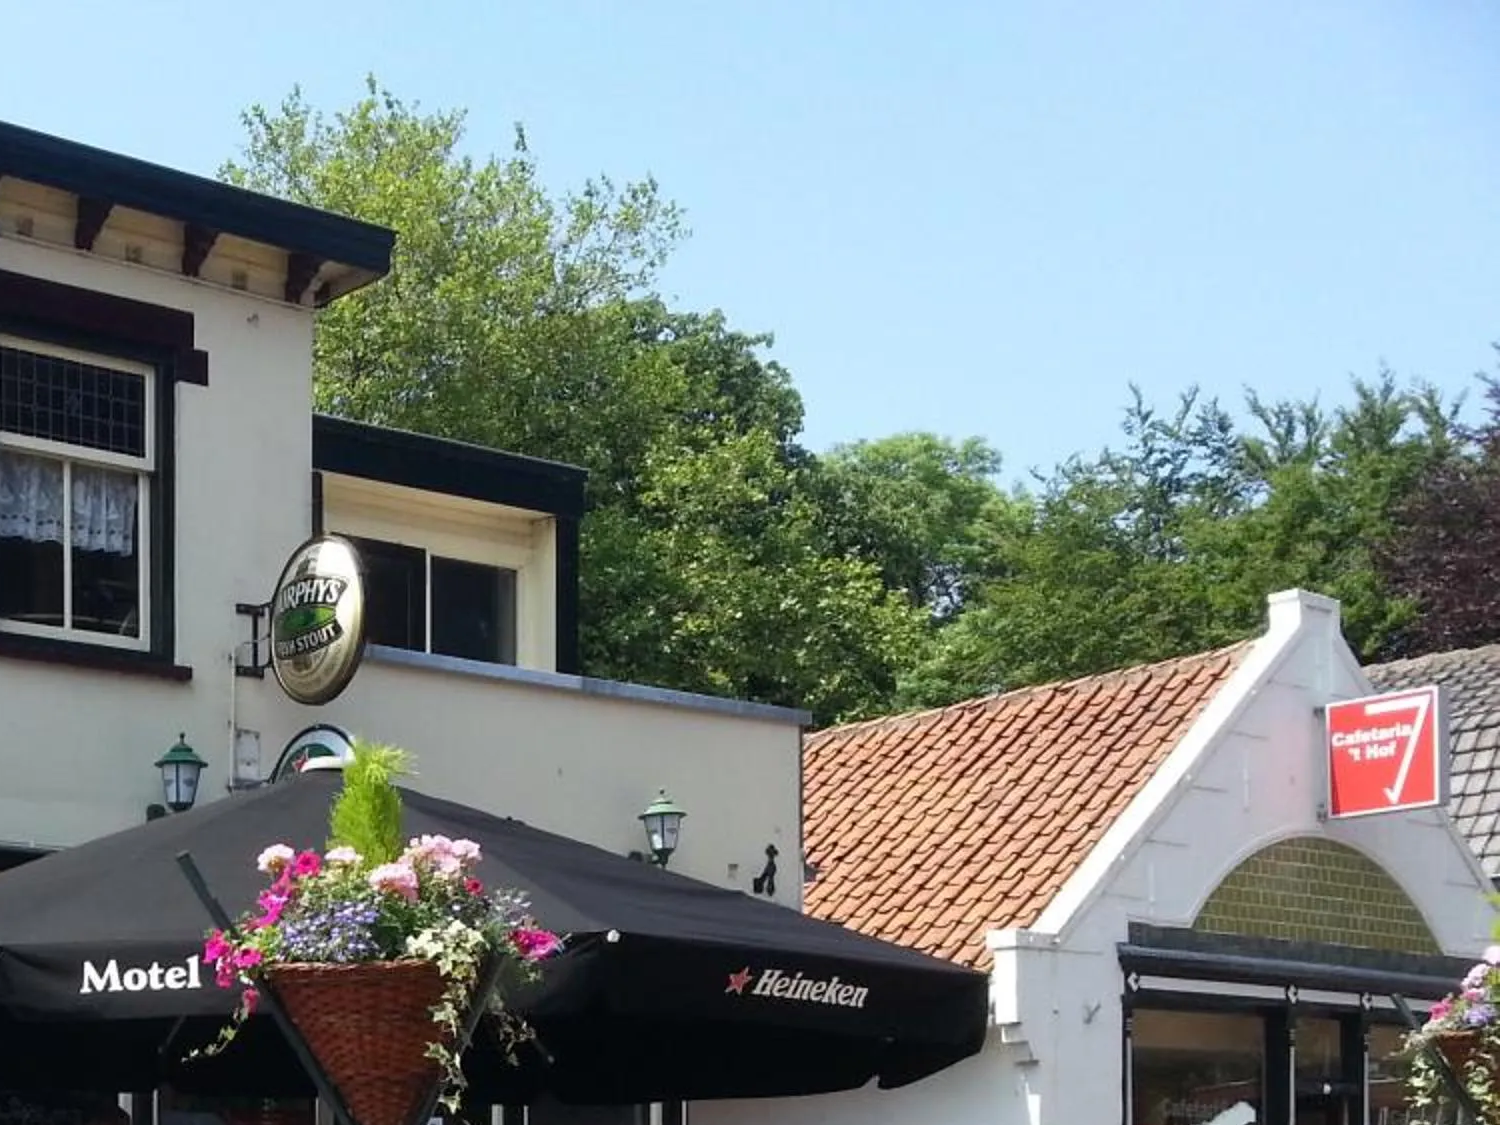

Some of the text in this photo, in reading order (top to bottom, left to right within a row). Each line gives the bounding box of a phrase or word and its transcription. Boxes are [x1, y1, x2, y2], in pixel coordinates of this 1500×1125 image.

[296, 623, 336, 652] STOUT
[1331, 722, 1412, 747] Cafetaria
[1365, 740, 1397, 759] Hof
[79, 953, 202, 995] Motel
[752, 968, 869, 1009] Heineken
